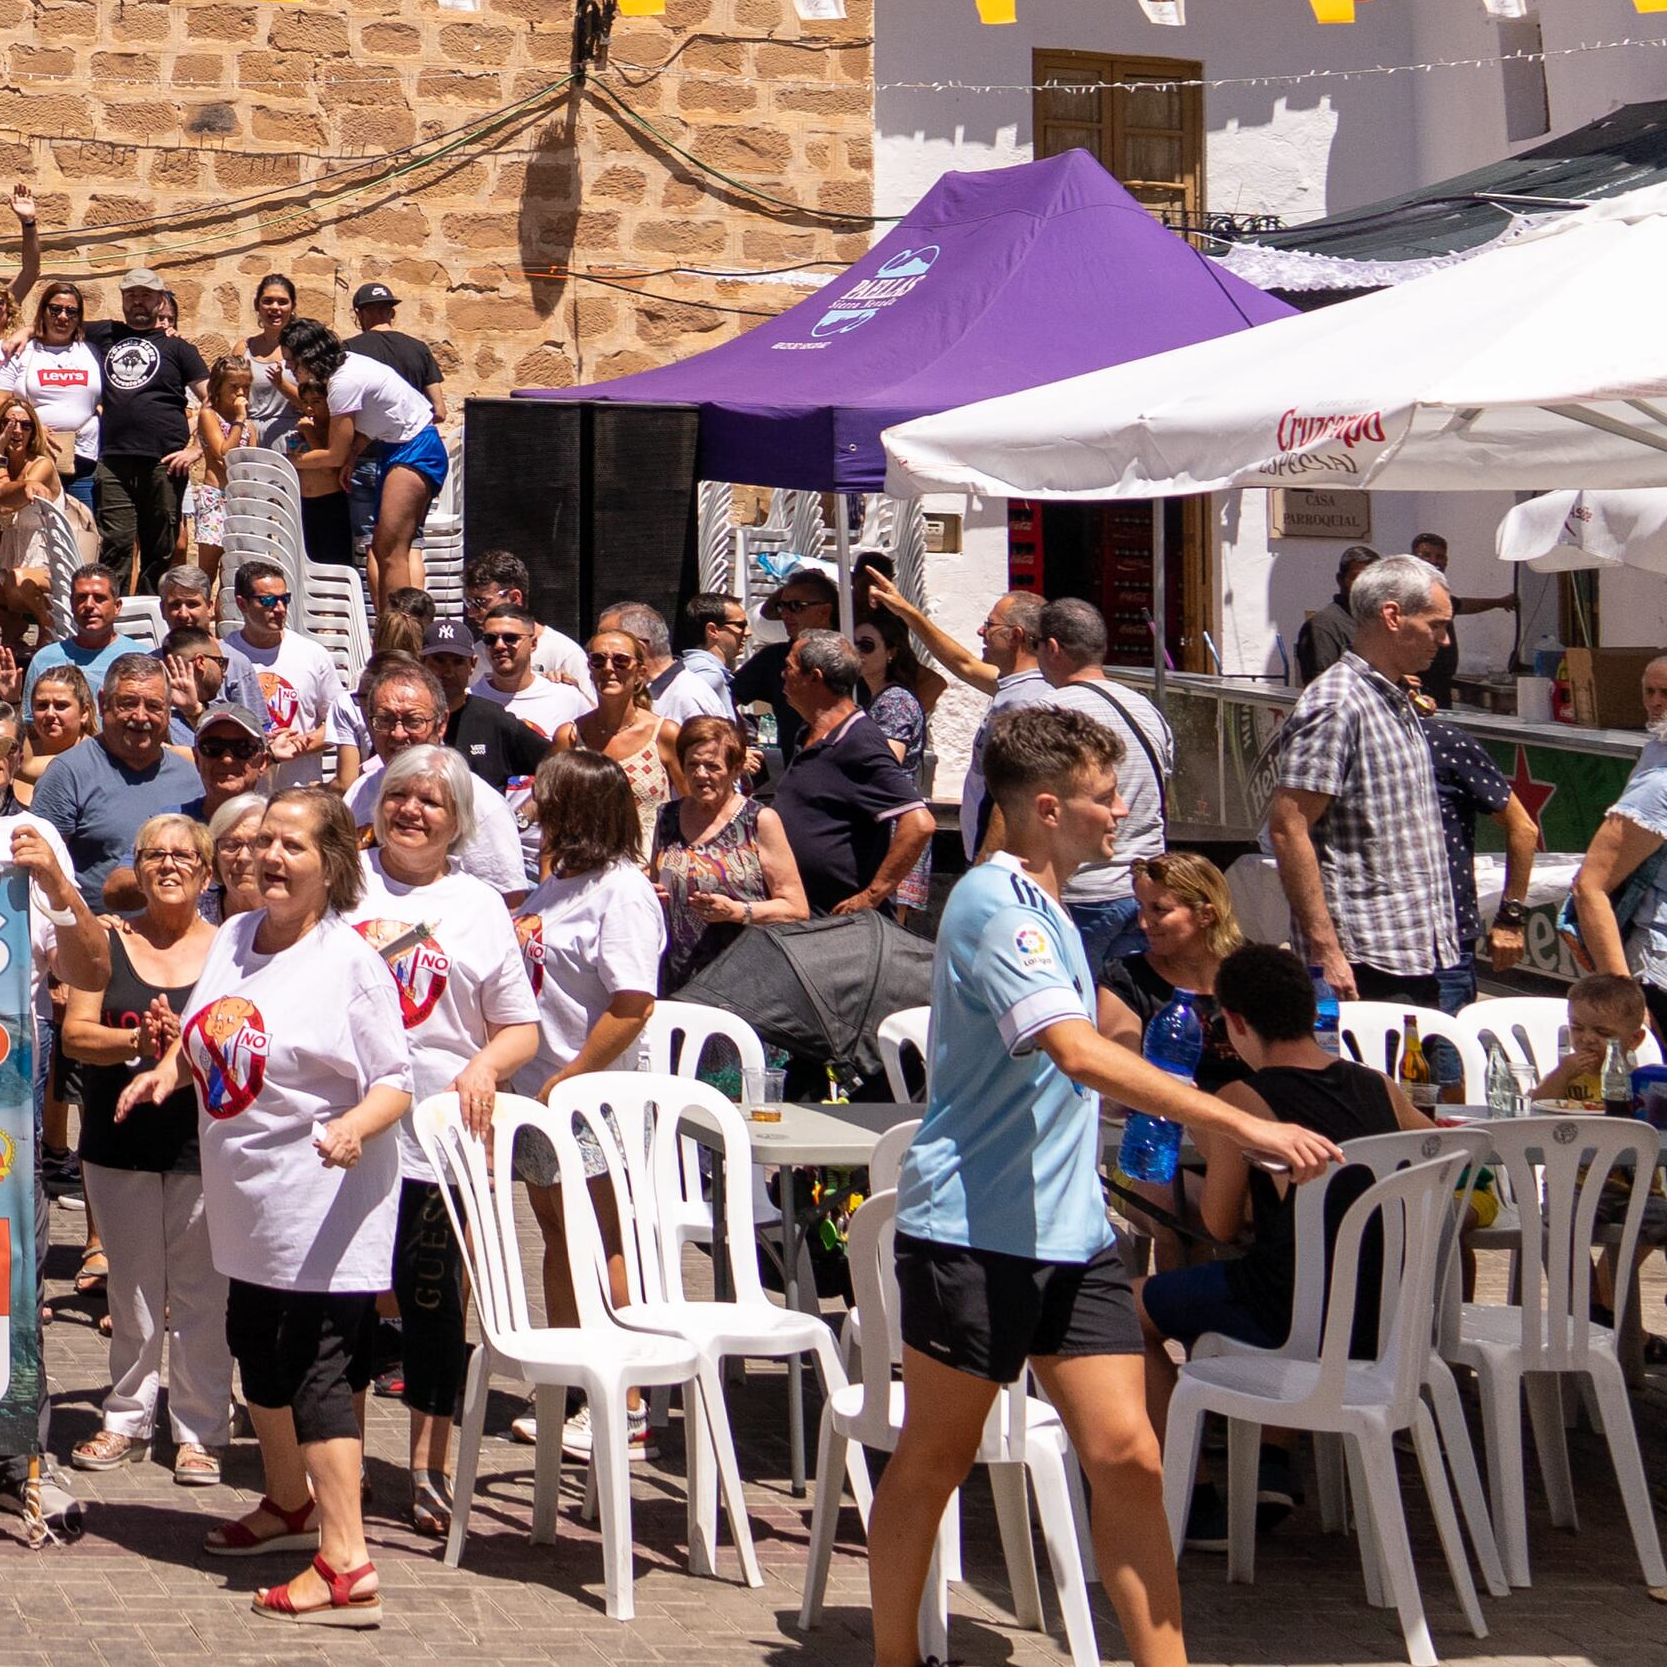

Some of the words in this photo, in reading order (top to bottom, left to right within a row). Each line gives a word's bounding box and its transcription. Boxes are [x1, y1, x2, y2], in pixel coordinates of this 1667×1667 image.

[840, 274, 927, 300] PAELLAS
[1305, 493, 1336, 507] CASA
[1283, 512, 1360, 528] PARROQUIAL
[282, 691, 298, 700] NO
[421, 953, 448, 971] NO
[240, 1032, 267, 1049] NO
